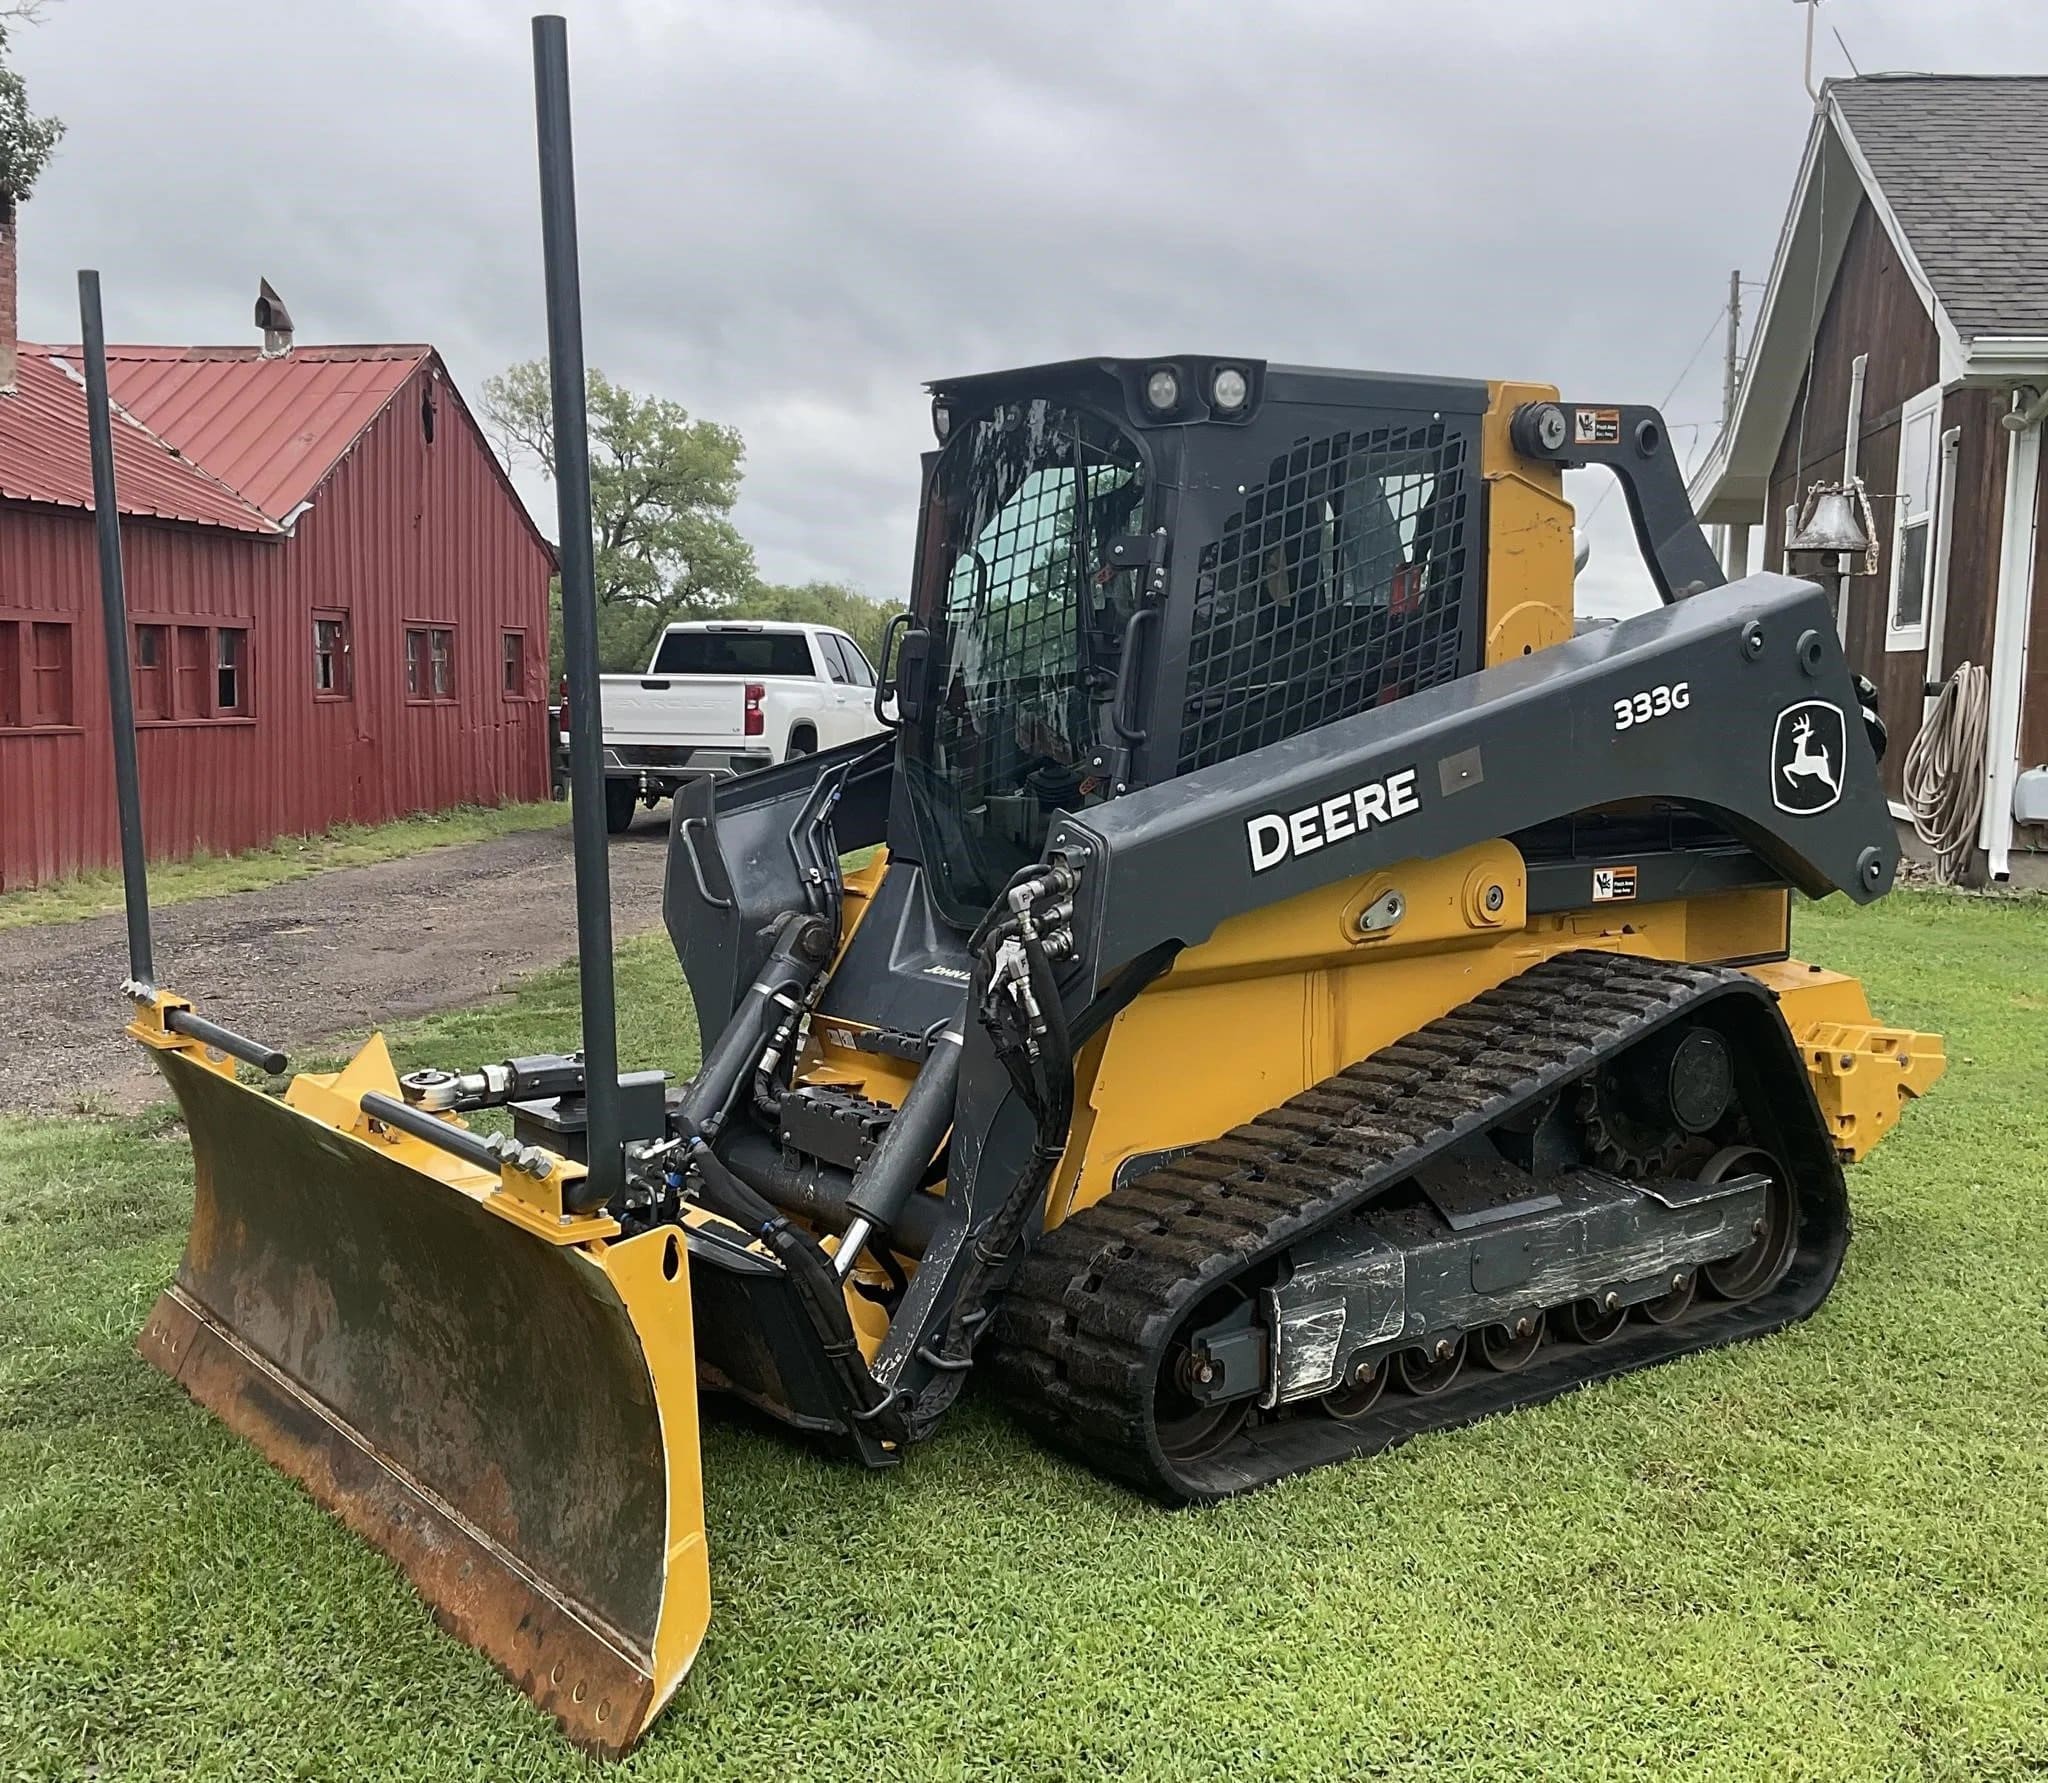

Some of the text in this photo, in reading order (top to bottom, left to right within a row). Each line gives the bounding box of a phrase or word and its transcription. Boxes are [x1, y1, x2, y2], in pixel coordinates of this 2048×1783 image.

[1613, 681, 1690, 730] 333G
[1247, 768, 1420, 872] DEERE
[923, 964, 965, 979] JOHN
